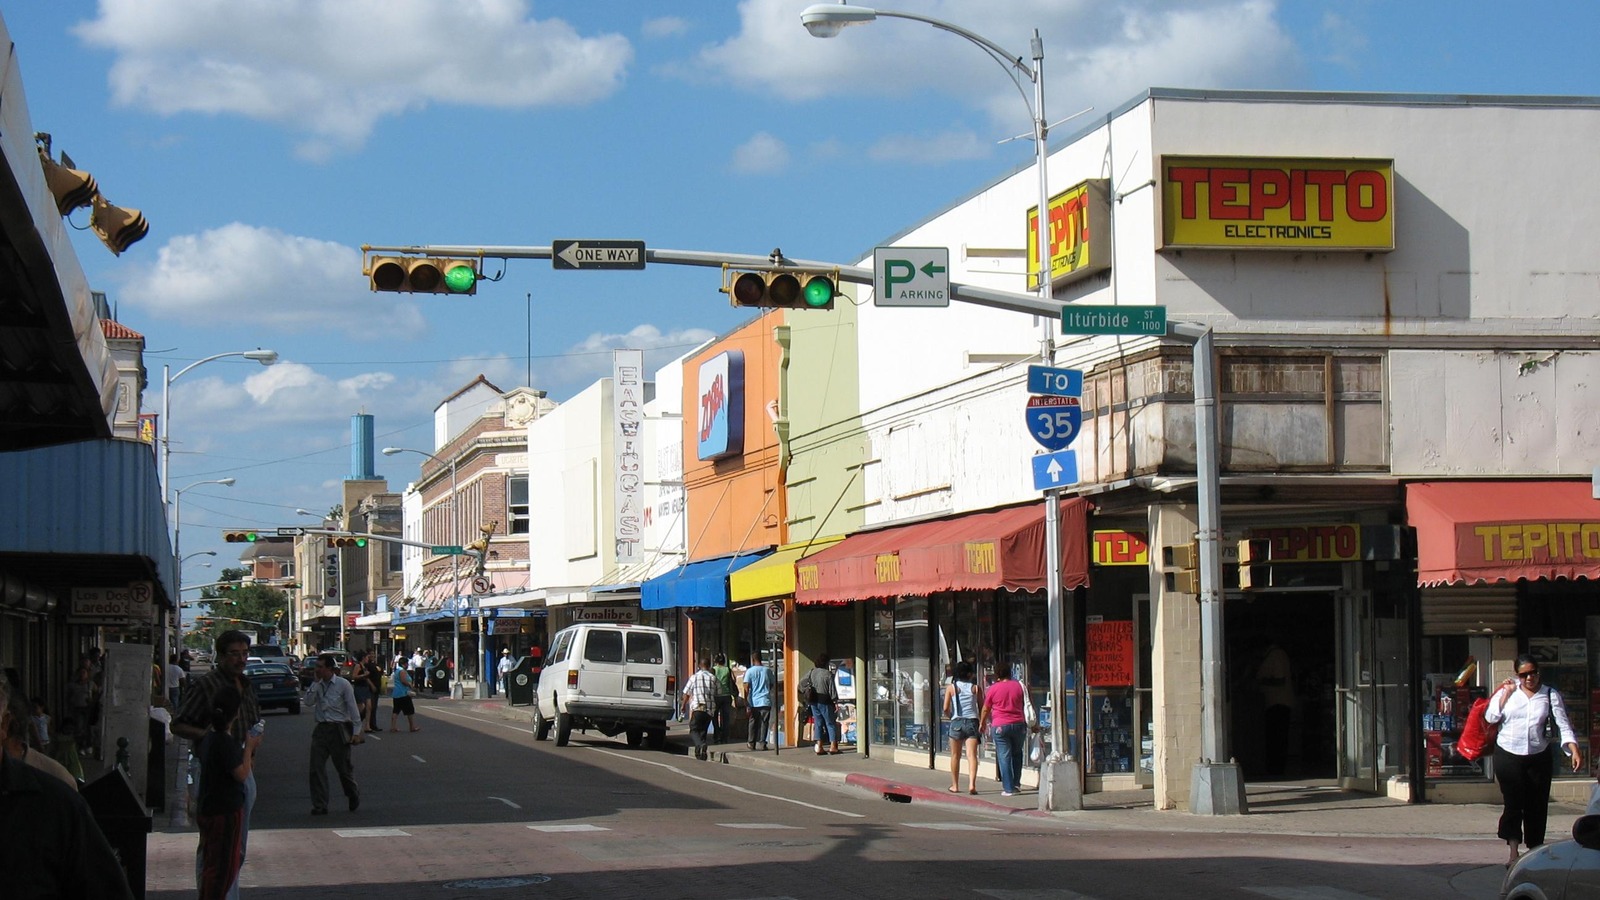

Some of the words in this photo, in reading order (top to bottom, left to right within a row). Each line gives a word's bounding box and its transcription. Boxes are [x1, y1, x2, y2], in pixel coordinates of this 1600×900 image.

[1168, 167, 1388, 222] TEPITO
[1224, 225, 1331, 239] ELECTRONICS
[575, 249, 602, 261] ONE
[607, 249, 634, 261] WAY
[1069, 312, 1129, 327] Iturbide
[1143, 310, 1154, 320] ST
[1141, 321, 1160, 330] 1100
[1042, 372, 1069, 390] TO
[1032, 397, 1073, 406] INTERSTATE
[1037, 412, 1073, 439] 35
[1475, 523, 1600, 561] TEPITO
[964, 542, 996, 574] TEPITO
[76, 590, 98, 600] Los
[106, 591, 129, 600] Dos
[74, 601, 129, 613] Laredo's
[576, 608, 633, 620] Zonalibre
